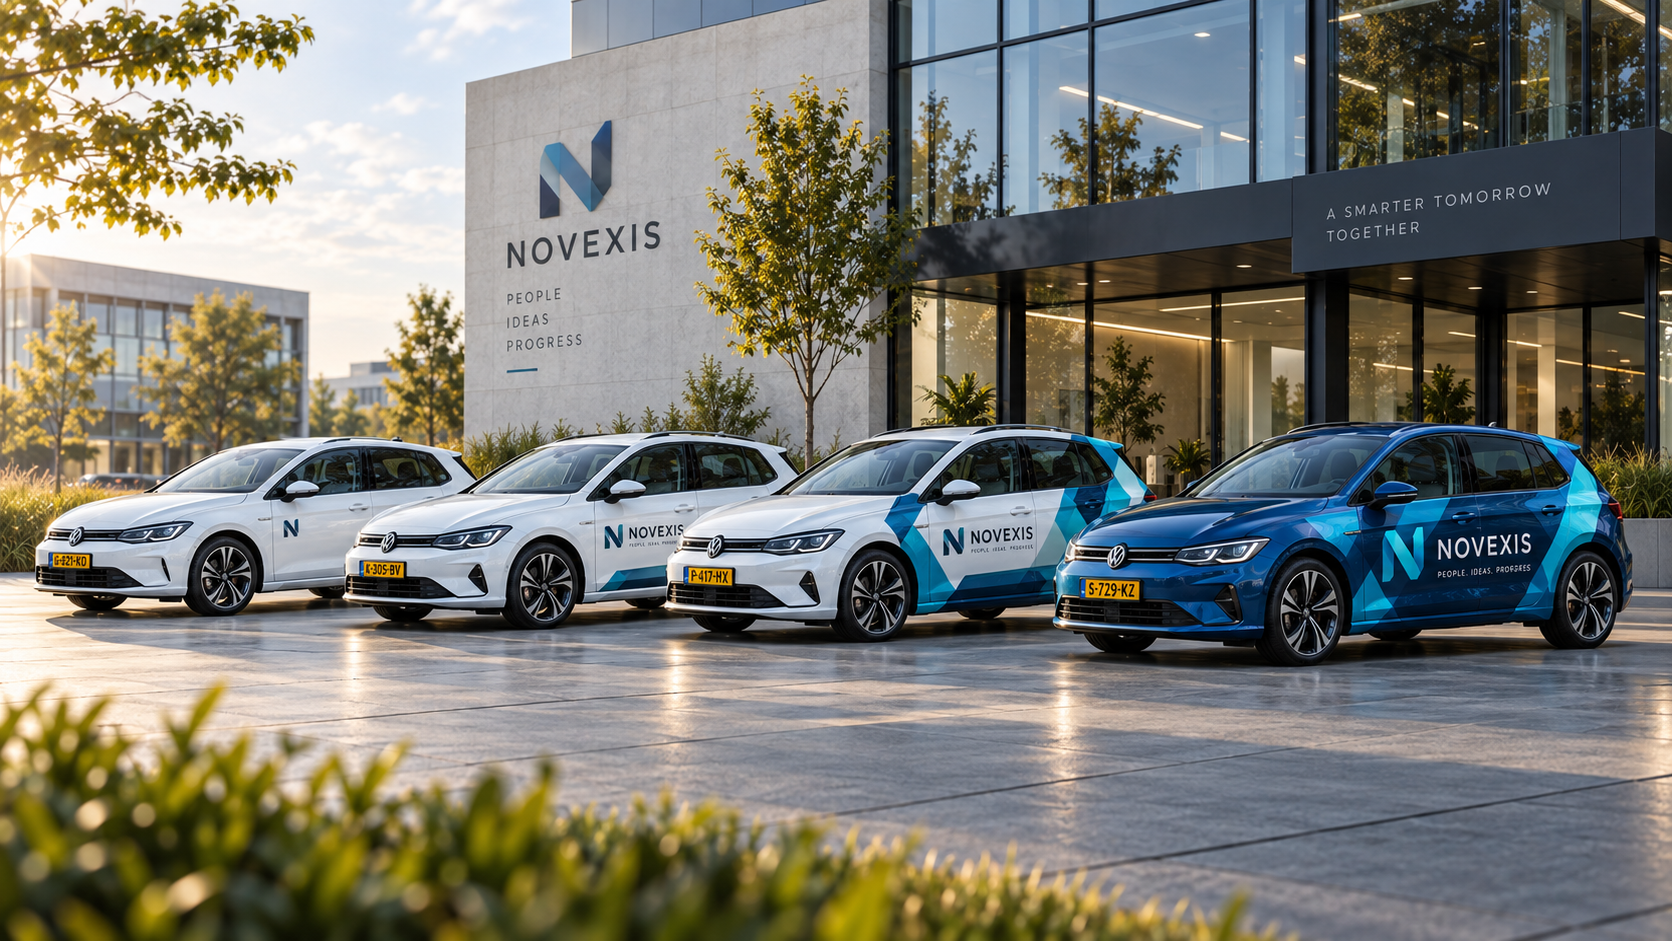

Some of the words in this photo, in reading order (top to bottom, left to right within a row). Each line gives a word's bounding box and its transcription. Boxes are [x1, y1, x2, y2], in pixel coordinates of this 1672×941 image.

[1326, 208, 1336, 220] A
[1344, 197, 1424, 218] SMARTER
[1434, 182, 1551, 208] TOMORROW
[1326, 221, 1420, 243] TOGETHER
[506, 220, 661, 269] NOVEXIS
[506, 288, 562, 306] PEOPLE
[506, 312, 549, 329] IDEAS
[506, 333, 583, 352] PROGRESS
[628, 524, 684, 540] NOVEXIS
[970, 526, 1034, 545] NOVEXIS
[1437, 532, 1532, 561] NOVEXIS
[690, 569, 729, 584] P-417-HX
[1088, 582, 1135, 598] S-729-KZ
